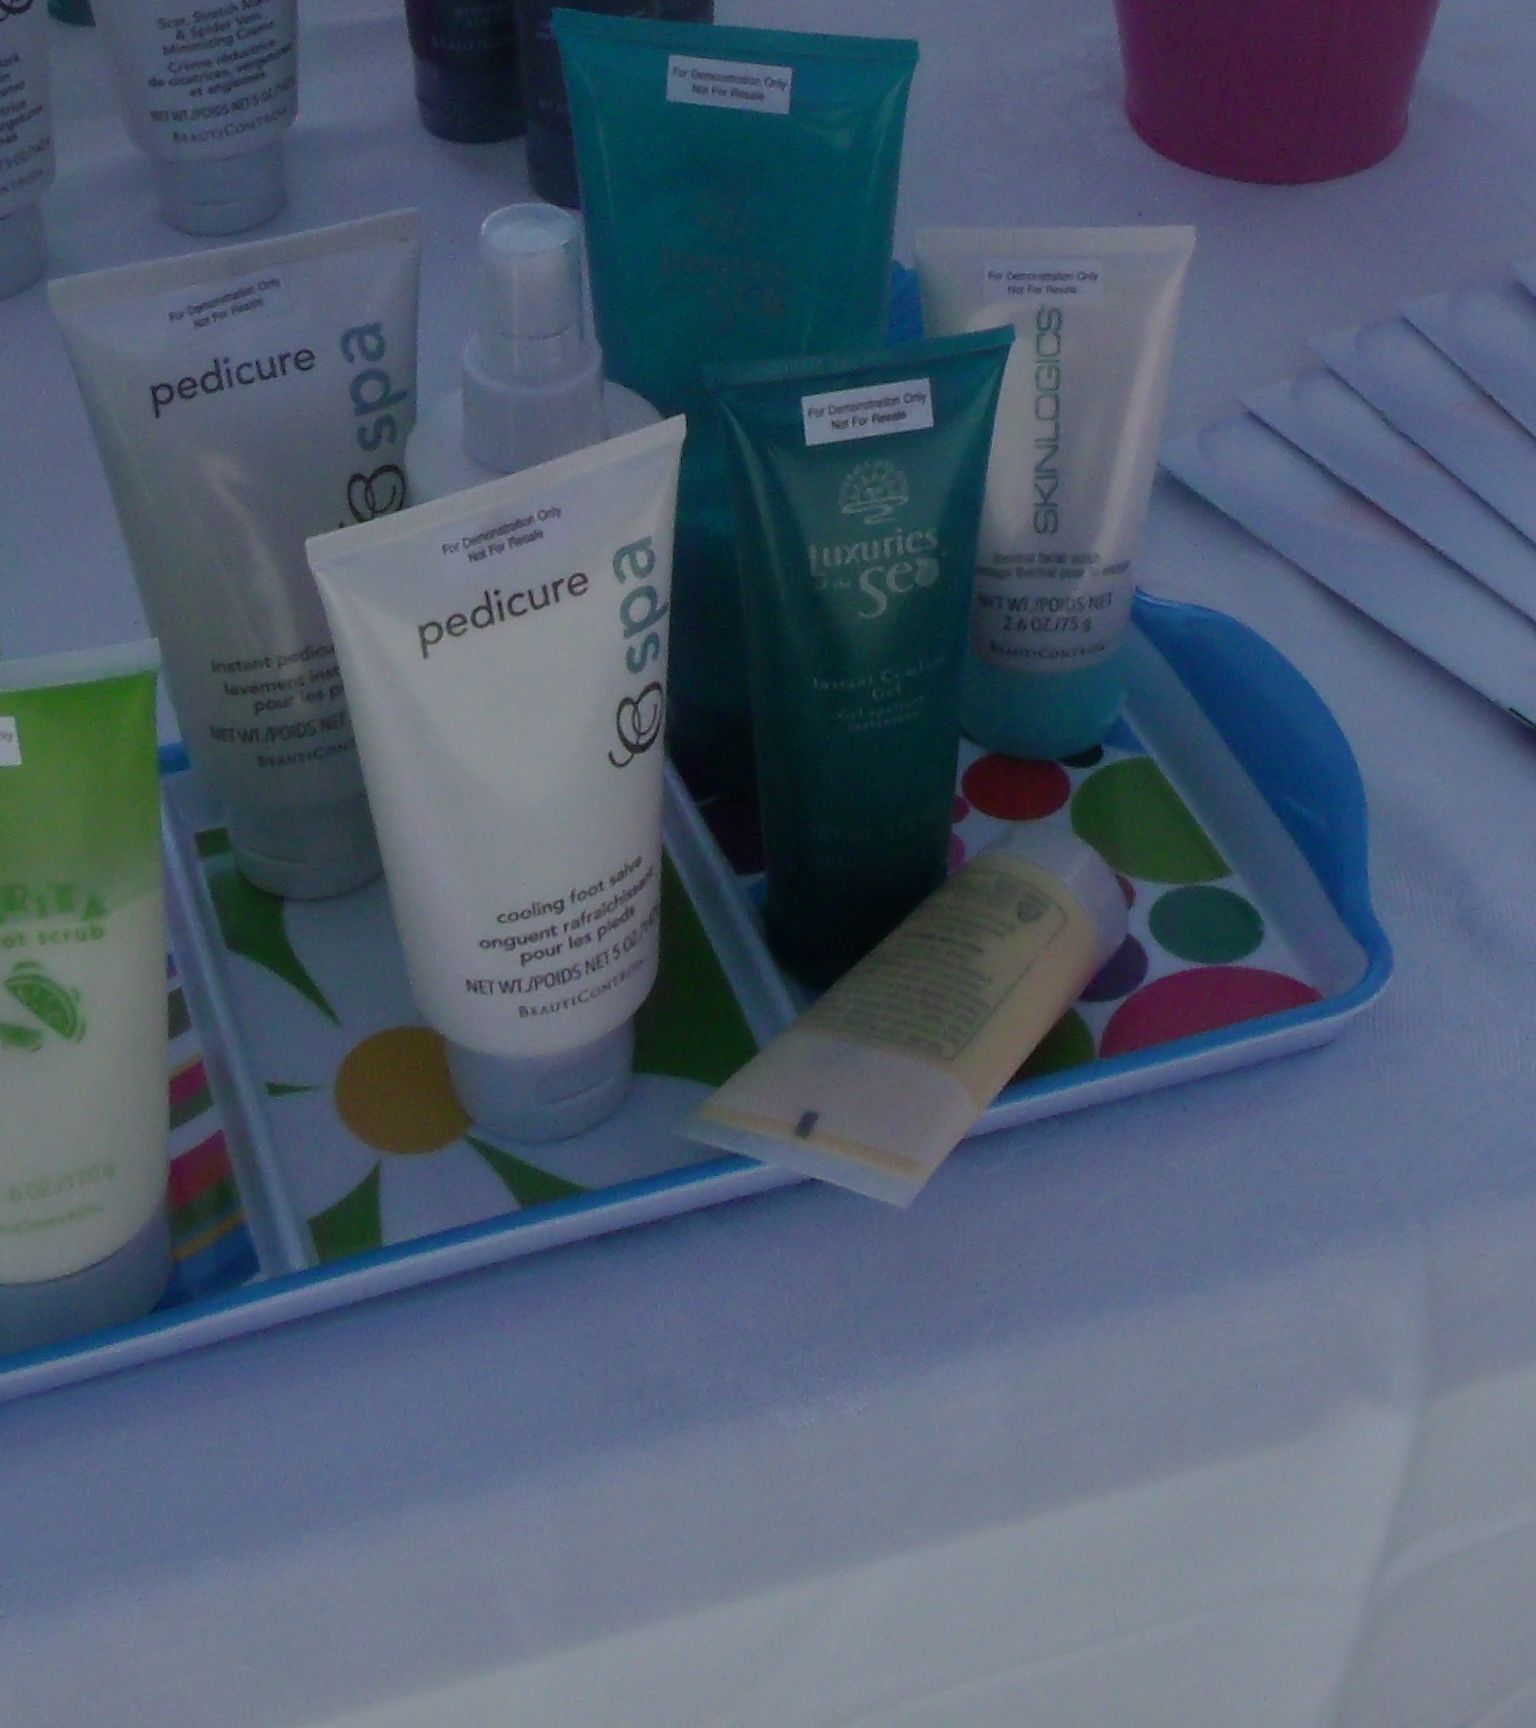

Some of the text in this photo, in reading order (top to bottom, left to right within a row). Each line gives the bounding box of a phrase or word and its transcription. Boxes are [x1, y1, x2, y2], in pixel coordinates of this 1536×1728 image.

[149, 347, 316, 419] pedicure
[340, 322, 409, 453] spa
[807, 390, 928, 419] For Demonstration Only
[831, 415, 850, 430] Not
[851, 413, 870, 427] For
[1032, 304, 1064, 535] SKINLOGICS
[442, 507, 563, 556] For Demonstration Only
[468, 529, 544, 563] Not For Resale
[417, 571, 590, 661] pedicure
[611, 535, 670, 675] spa
[211, 644, 335, 673] instant pedicu
[253, 688, 324, 716] pour les
[256, 737, 356, 768] BEAUTICON
[496, 855, 643, 925] cooling foot salve
[37, 924, 106, 946] scrub
[478, 925, 559, 952] onguent
[520, 943, 563, 968] pour
[568, 931, 594, 950] les
[596, 906, 637, 943] pieds
[465, 978, 495, 996] NET
[585, 951, 611, 975] NET
[613, 943, 622, 961] 5
